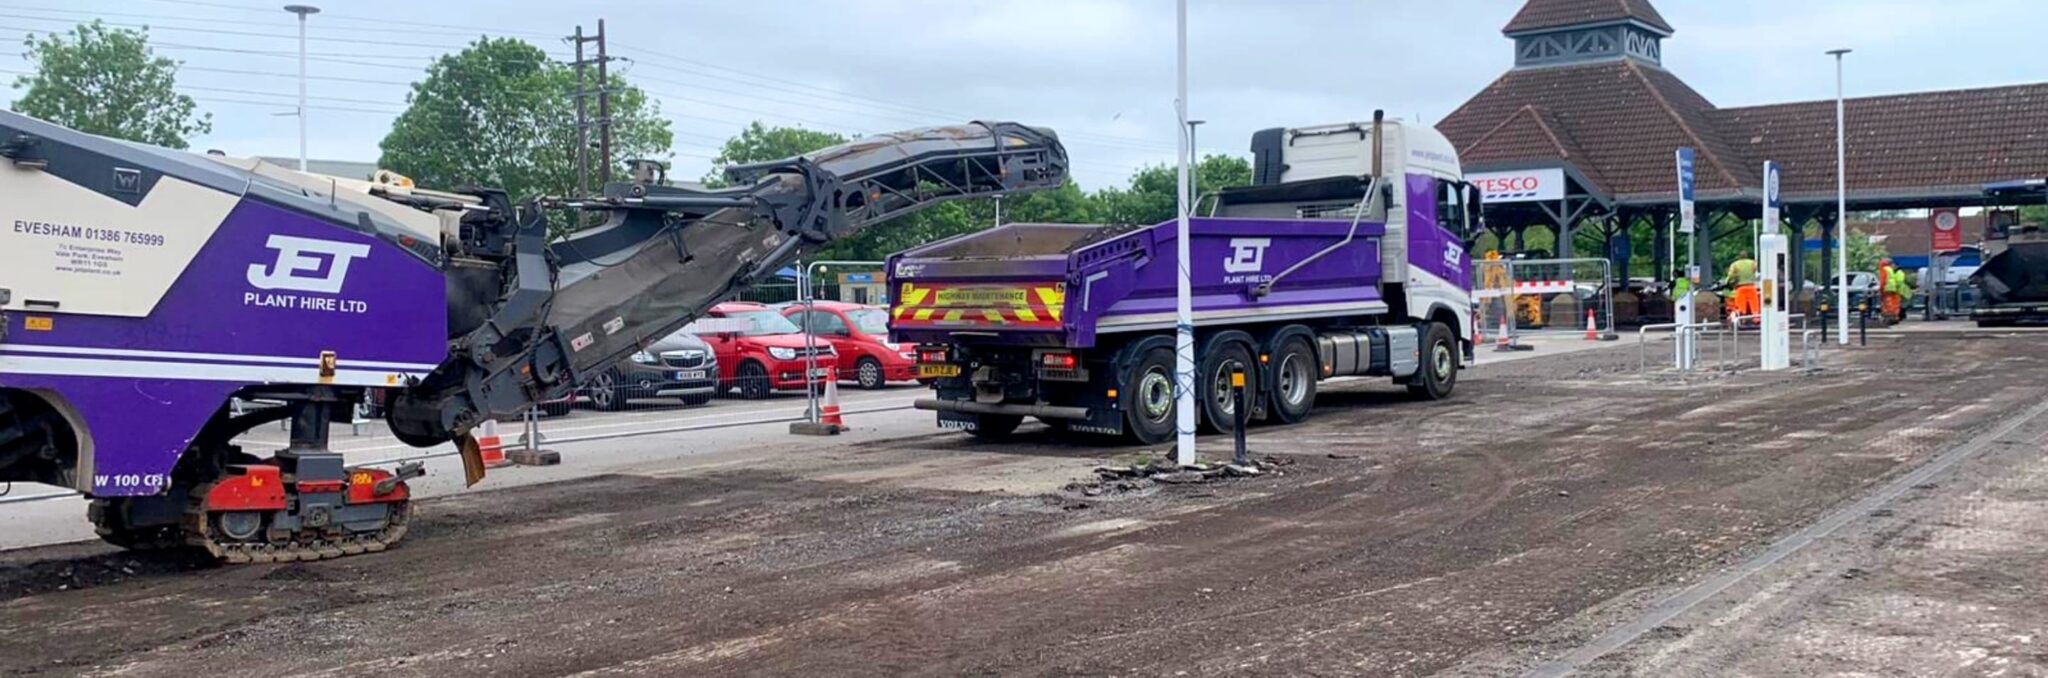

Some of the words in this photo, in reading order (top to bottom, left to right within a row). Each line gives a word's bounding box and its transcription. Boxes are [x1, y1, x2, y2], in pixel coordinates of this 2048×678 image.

[14, 220, 82, 238] EVESHAM
[85, 228, 121, 243] 01386
[124, 231, 165, 246] 765999
[91, 254, 124, 262] Evesham
[1223, 237, 1271, 273] JET
[1444, 240, 1464, 266] JET
[247, 234, 371, 294] JET
[1223, 275, 1245, 284] PLANT
[937, 291, 970, 301] HIGHWAY
[972, 289, 1025, 301] MAINTENANCE
[244, 292, 297, 308] PLANT
[300, 297, 337, 311] HIRE
[340, 300, 368, 313] LTD
[939, 419, 976, 431] VOLVO
[1072, 424, 1117, 435] VOLVO
[94, 474, 109, 487] W
[113, 474, 140, 487] 100
